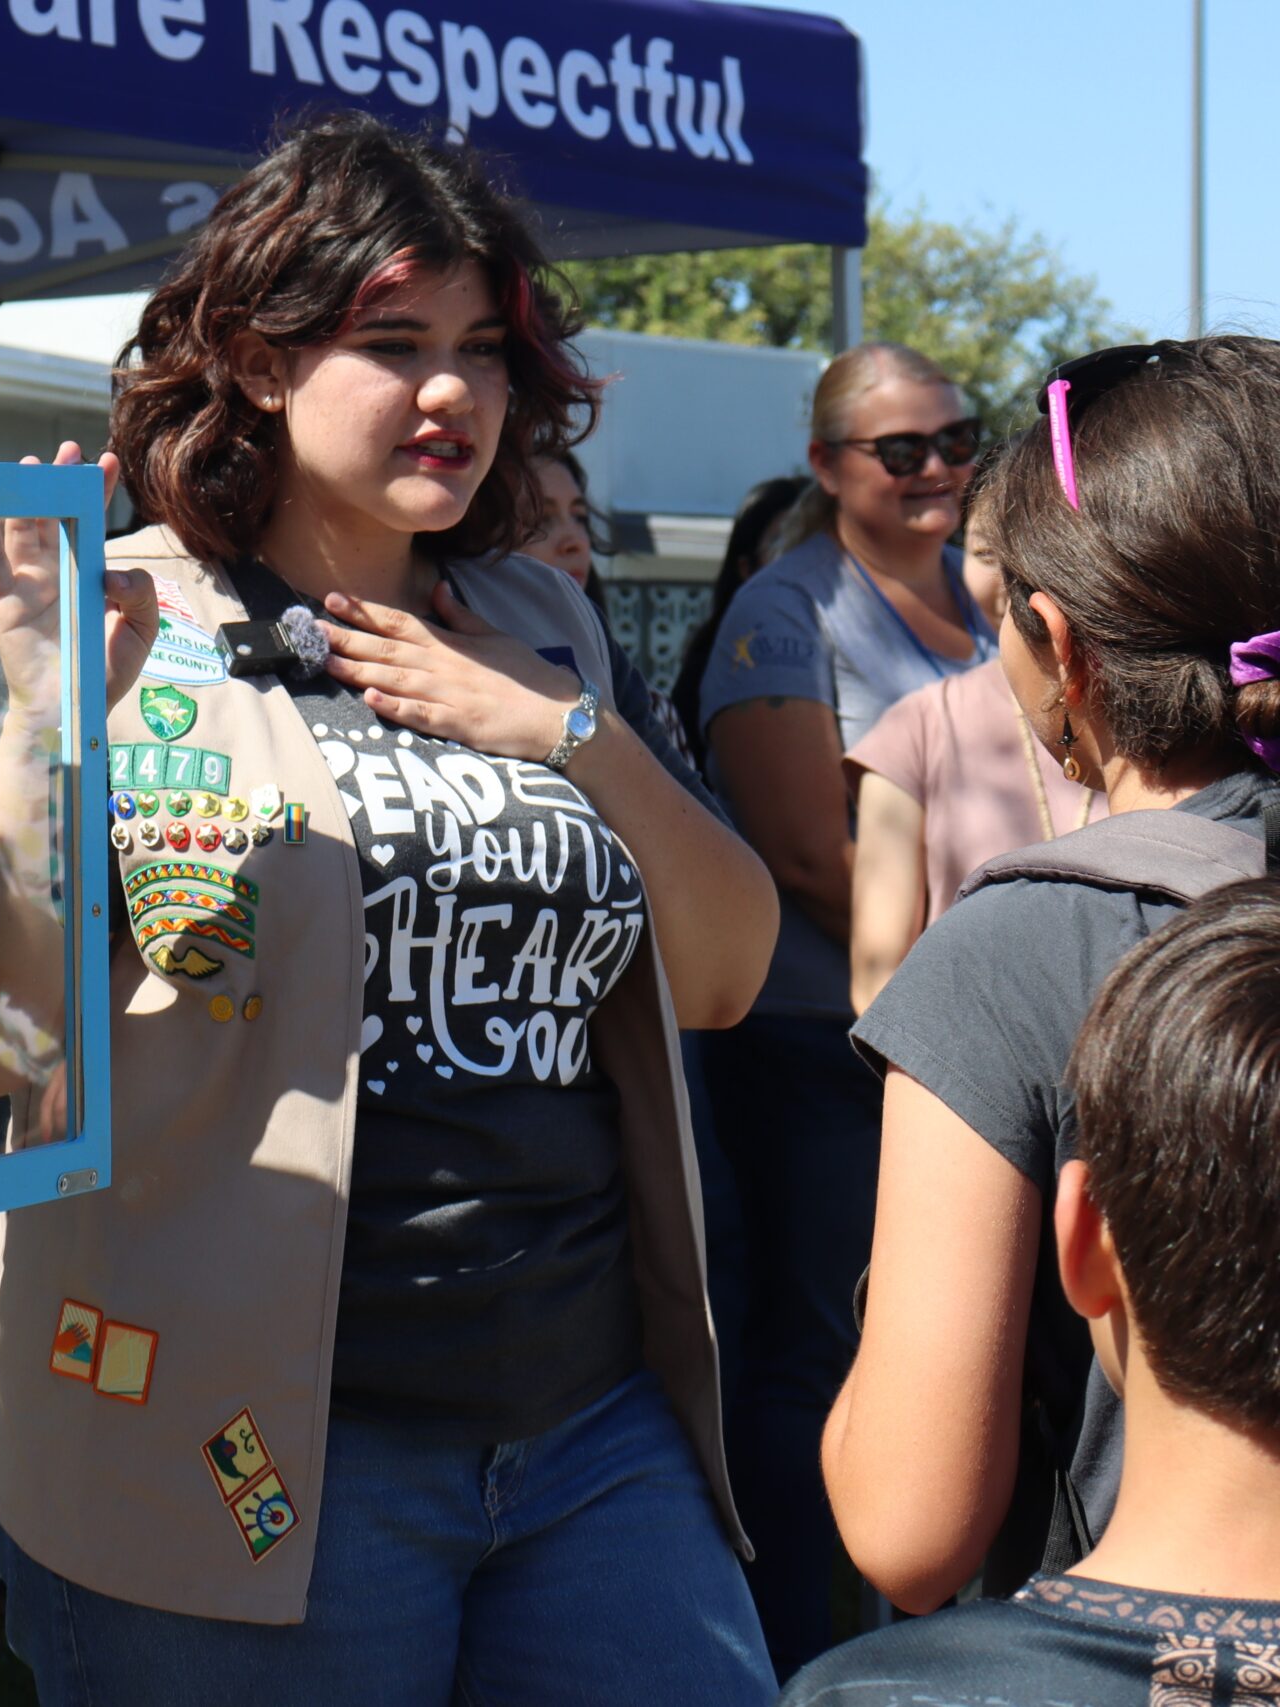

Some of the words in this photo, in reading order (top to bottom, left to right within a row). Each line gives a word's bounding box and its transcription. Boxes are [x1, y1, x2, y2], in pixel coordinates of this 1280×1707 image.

[245, 0, 754, 165] Respectful
[168, 654, 218, 675] COUNTY
[114, 754, 224, 786] 2479
[317, 740, 506, 835] READ
[425, 810, 614, 904] your
